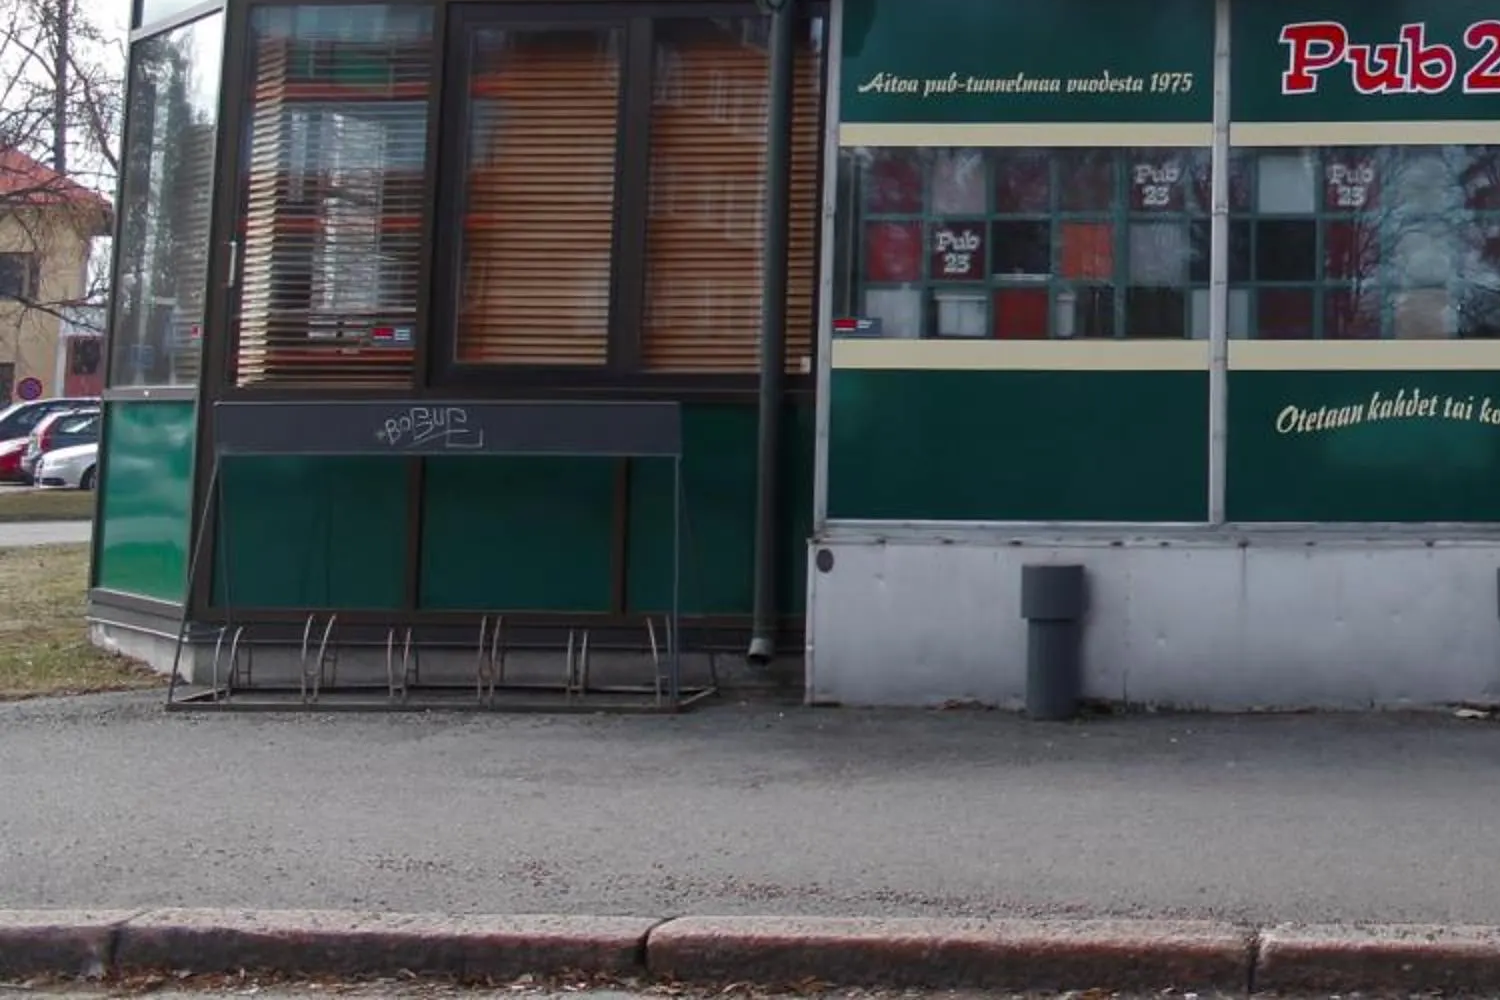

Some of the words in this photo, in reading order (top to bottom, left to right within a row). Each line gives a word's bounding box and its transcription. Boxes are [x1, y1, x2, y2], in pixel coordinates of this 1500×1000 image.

[1280, 21, 1456, 94] Pub
[858, 70, 917, 93] Aitoa
[923, 72, 1061, 97] pub-tunnelmaa
[1066, 70, 1144, 93] vuodesta
[1149, 72, 1193, 93] 1975
[1134, 163, 1181, 184] Pub
[1327, 162, 1375, 185] Pub
[1142, 185, 1170, 206] 23
[1337, 186, 1365, 207] 23
[936, 229, 981, 251] Pub
[943, 253, 971, 273] 23
[1276, 403, 1364, 433] Otetaan
[1367, 387, 1438, 421] kahdet
[1443, 396, 1474, 420] tai
